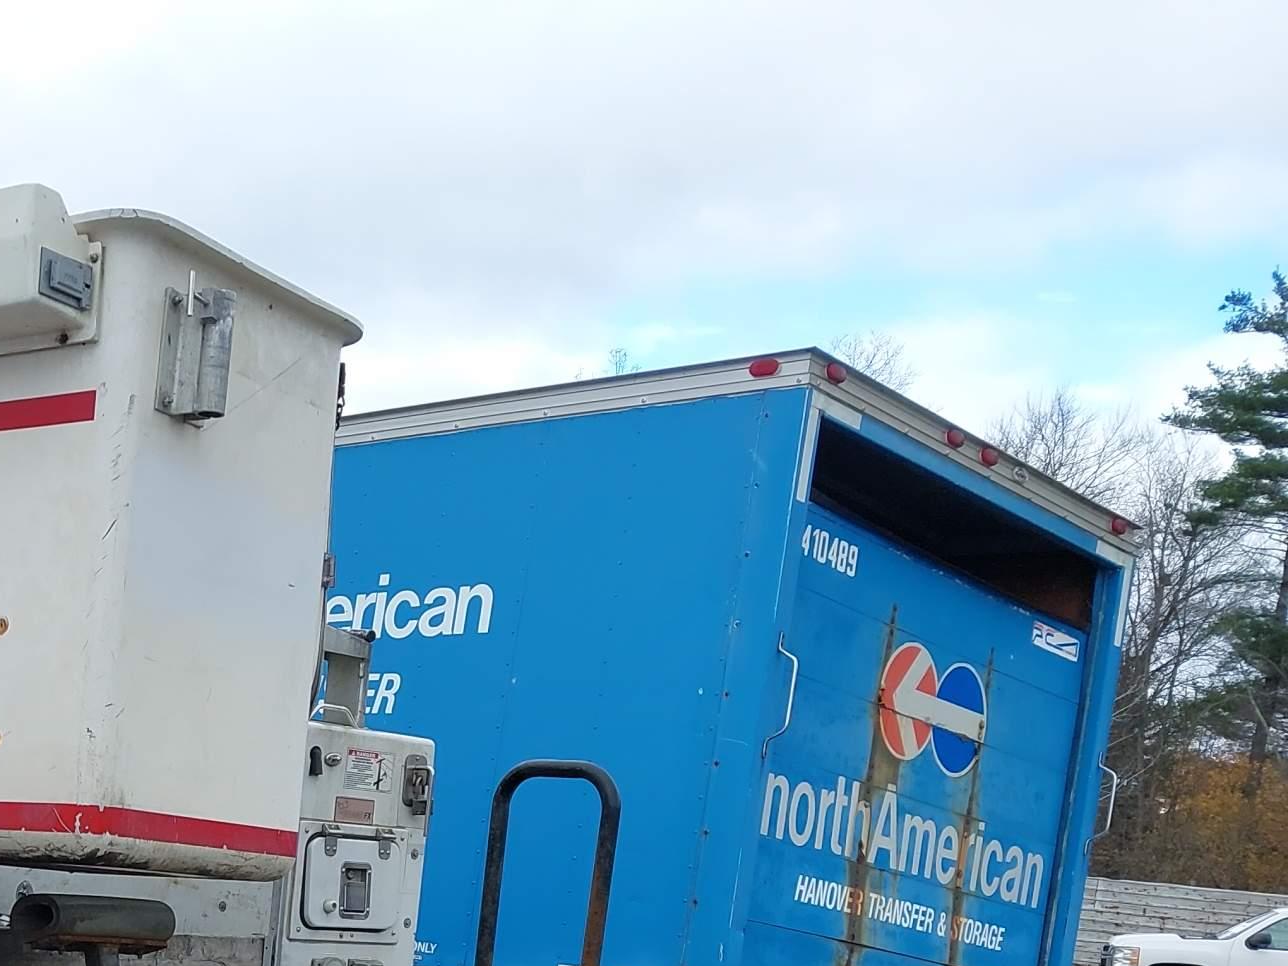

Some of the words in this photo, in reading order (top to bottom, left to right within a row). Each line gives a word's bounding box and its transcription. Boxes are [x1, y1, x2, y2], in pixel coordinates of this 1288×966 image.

[801, 524, 859, 577] 410489
[760, 772, 1045, 909] northAmerican
[794, 874, 864, 916] HANOVER
[868, 892, 935, 933] TRANSFER
[937, 911, 947, 938] &
[950, 915, 1006, 951] STORAGE
